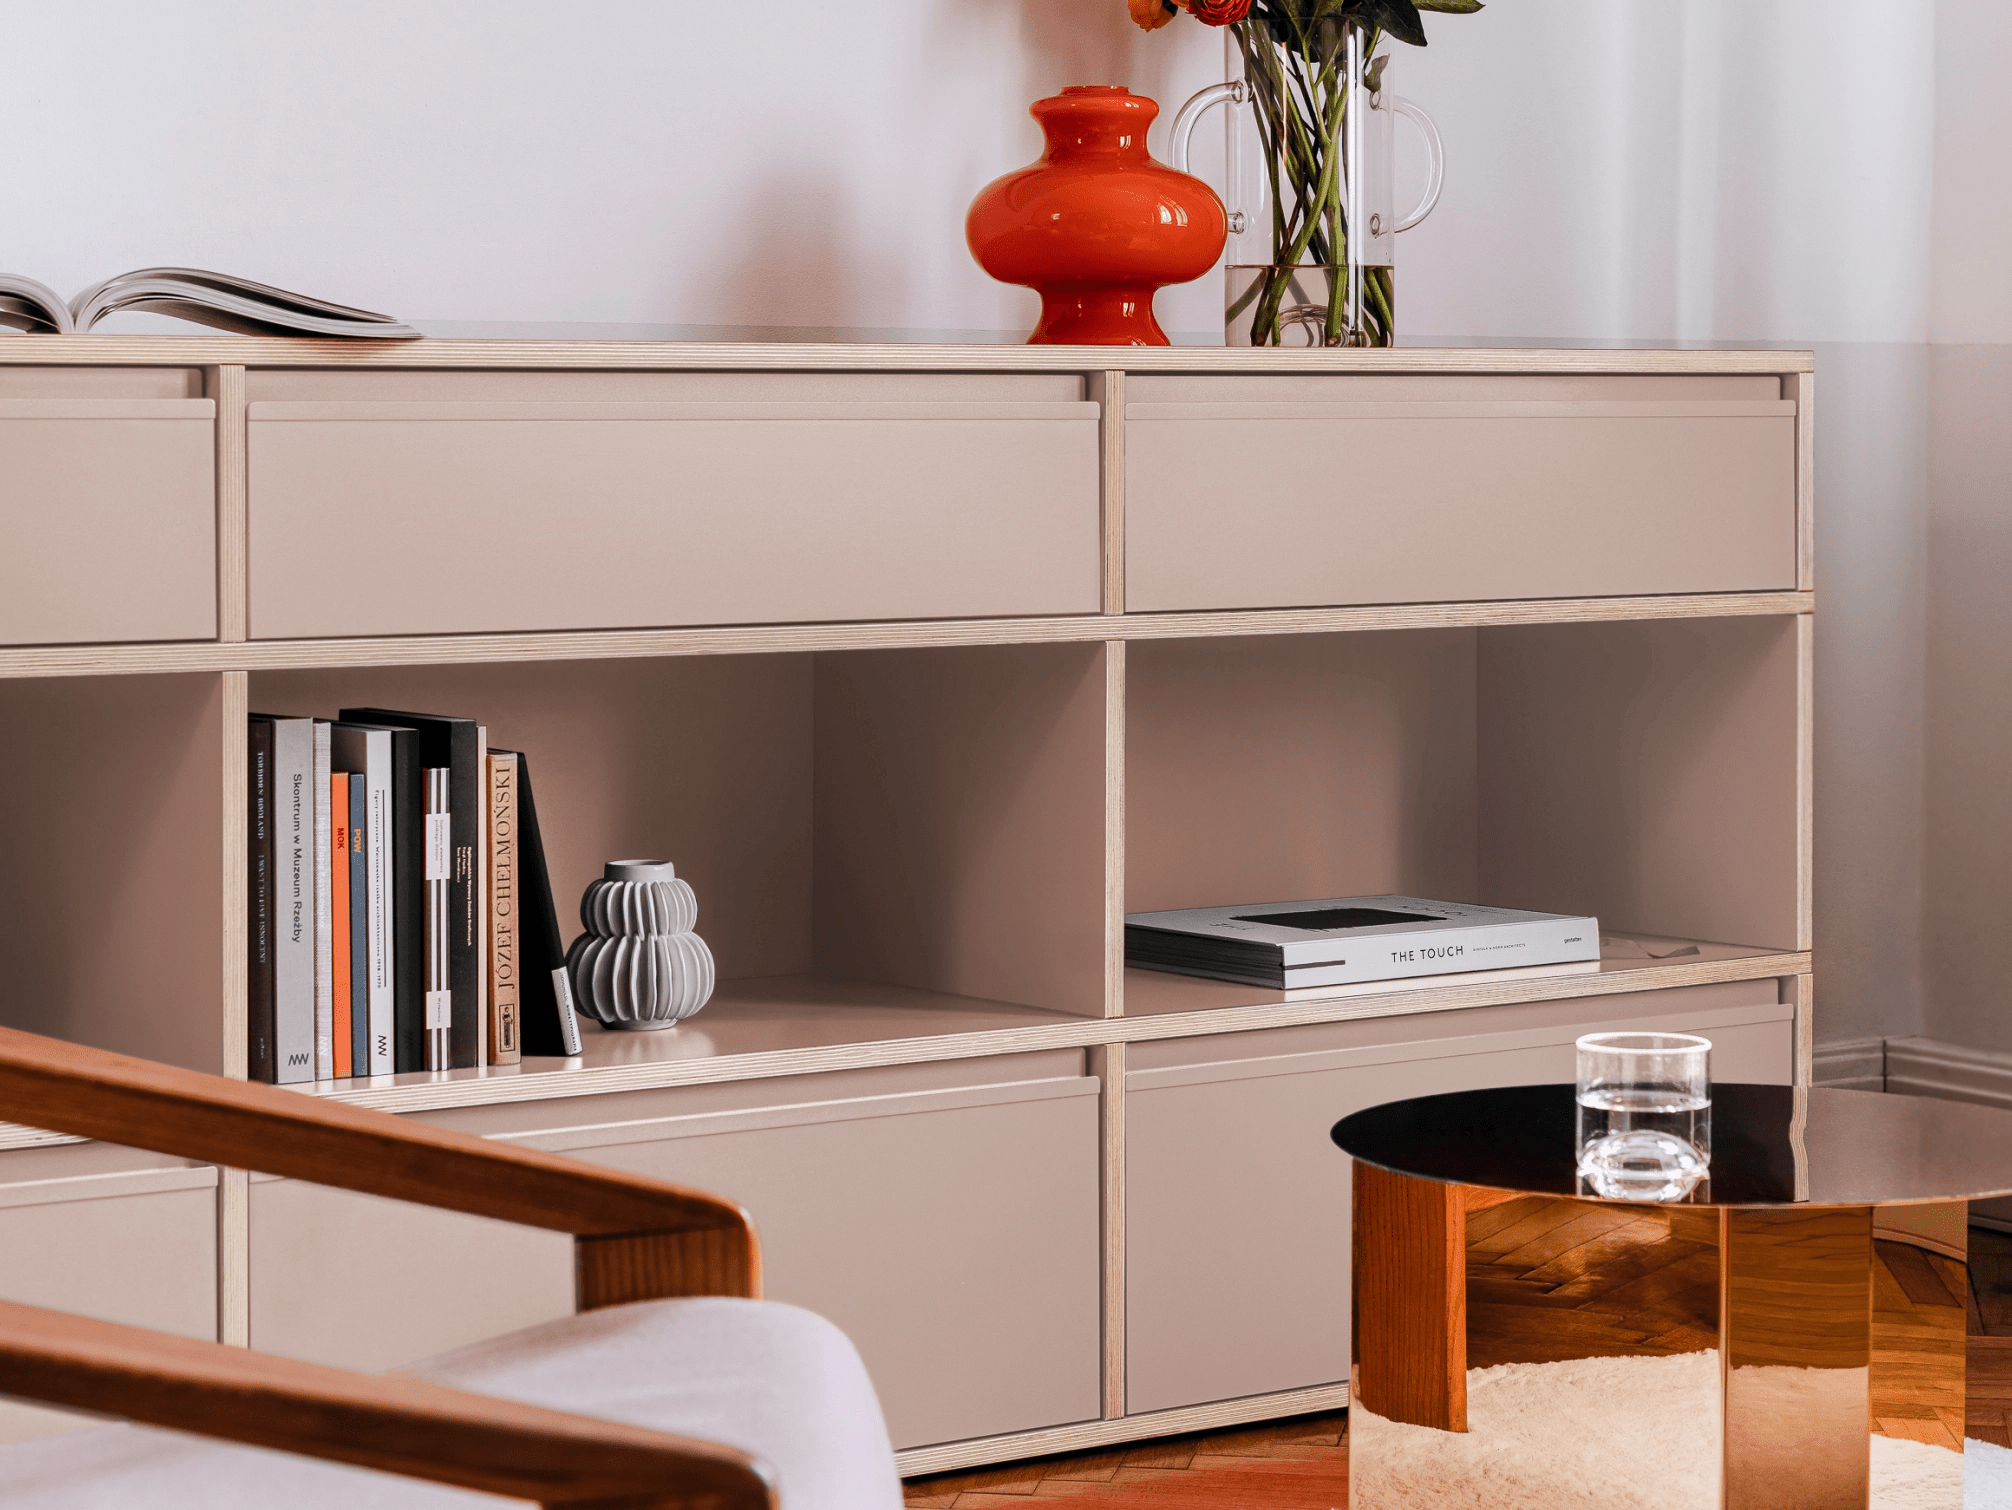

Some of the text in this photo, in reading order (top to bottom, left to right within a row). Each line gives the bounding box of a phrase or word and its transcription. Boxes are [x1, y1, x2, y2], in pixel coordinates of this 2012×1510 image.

[337, 828, 345, 849] MOK
[353, 828, 362, 853] POW
[292, 773, 303, 943] Skontrum w Muzeum Rzeźby
[494, 768, 515, 990] JÓZEF CHEŁMOŃSKI
[1391, 945, 1465, 963] THE TOUCH
